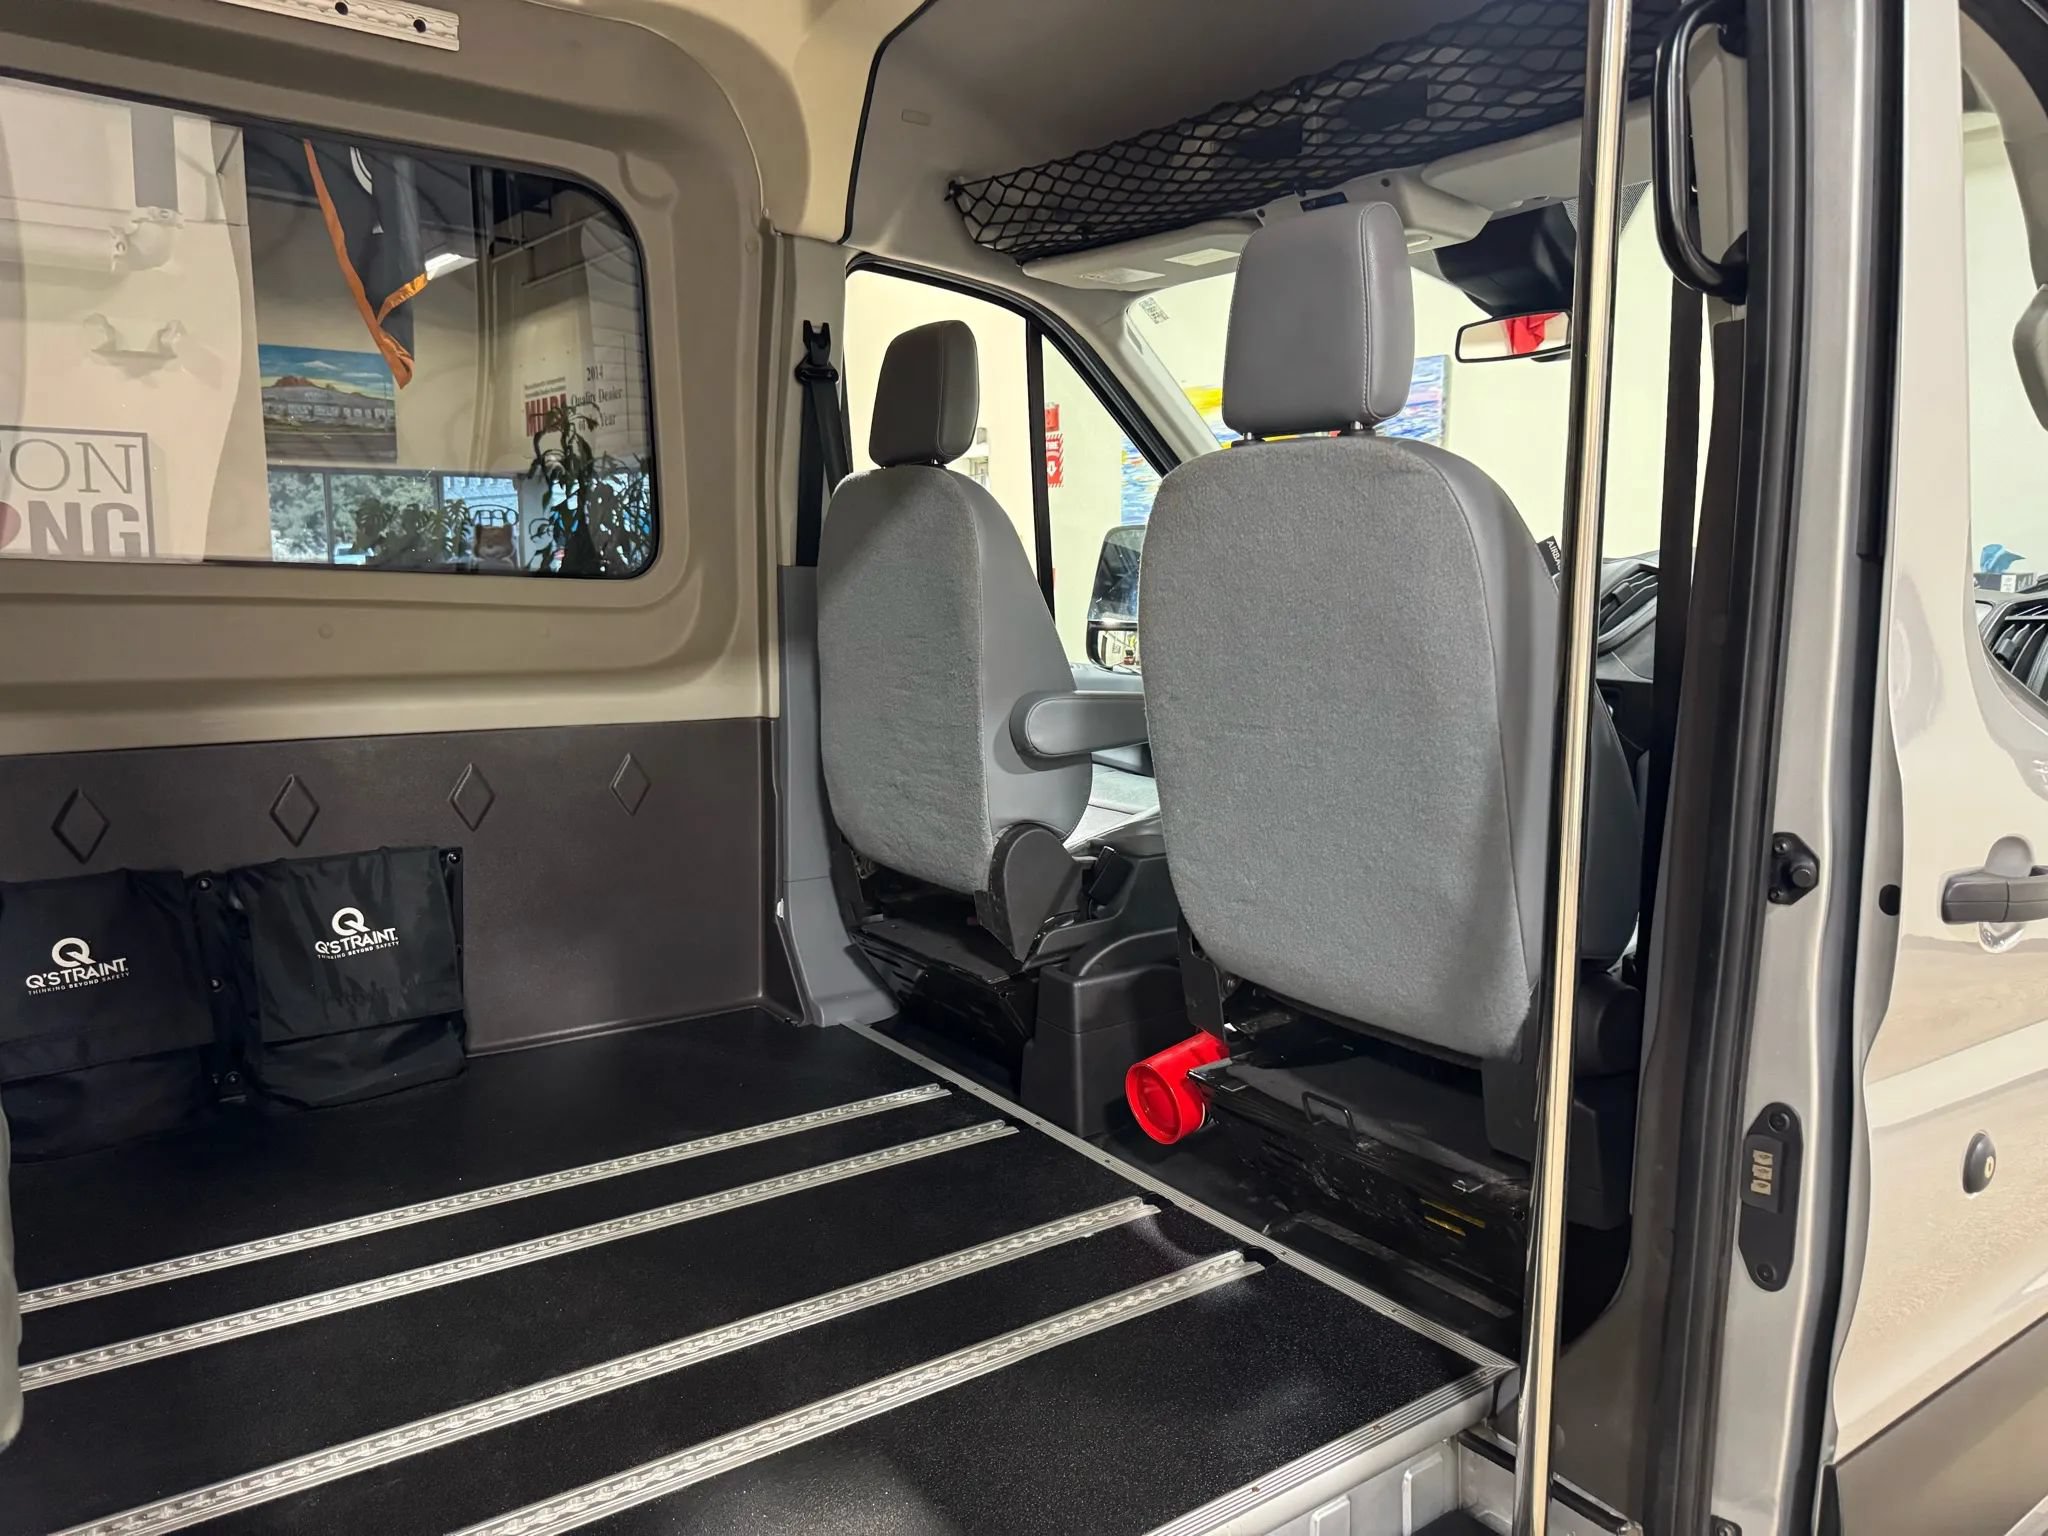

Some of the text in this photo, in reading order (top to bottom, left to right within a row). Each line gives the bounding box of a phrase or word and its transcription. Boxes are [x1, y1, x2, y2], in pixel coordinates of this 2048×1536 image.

[571, 385, 623, 406] Quality Dealer
[0, 438, 137, 494] ON
[348, 946, 374, 956] BEYOND
[376, 940, 400, 950] SAFETY
[28, 971, 130, 997] THINKING BEYOND SAFETY
